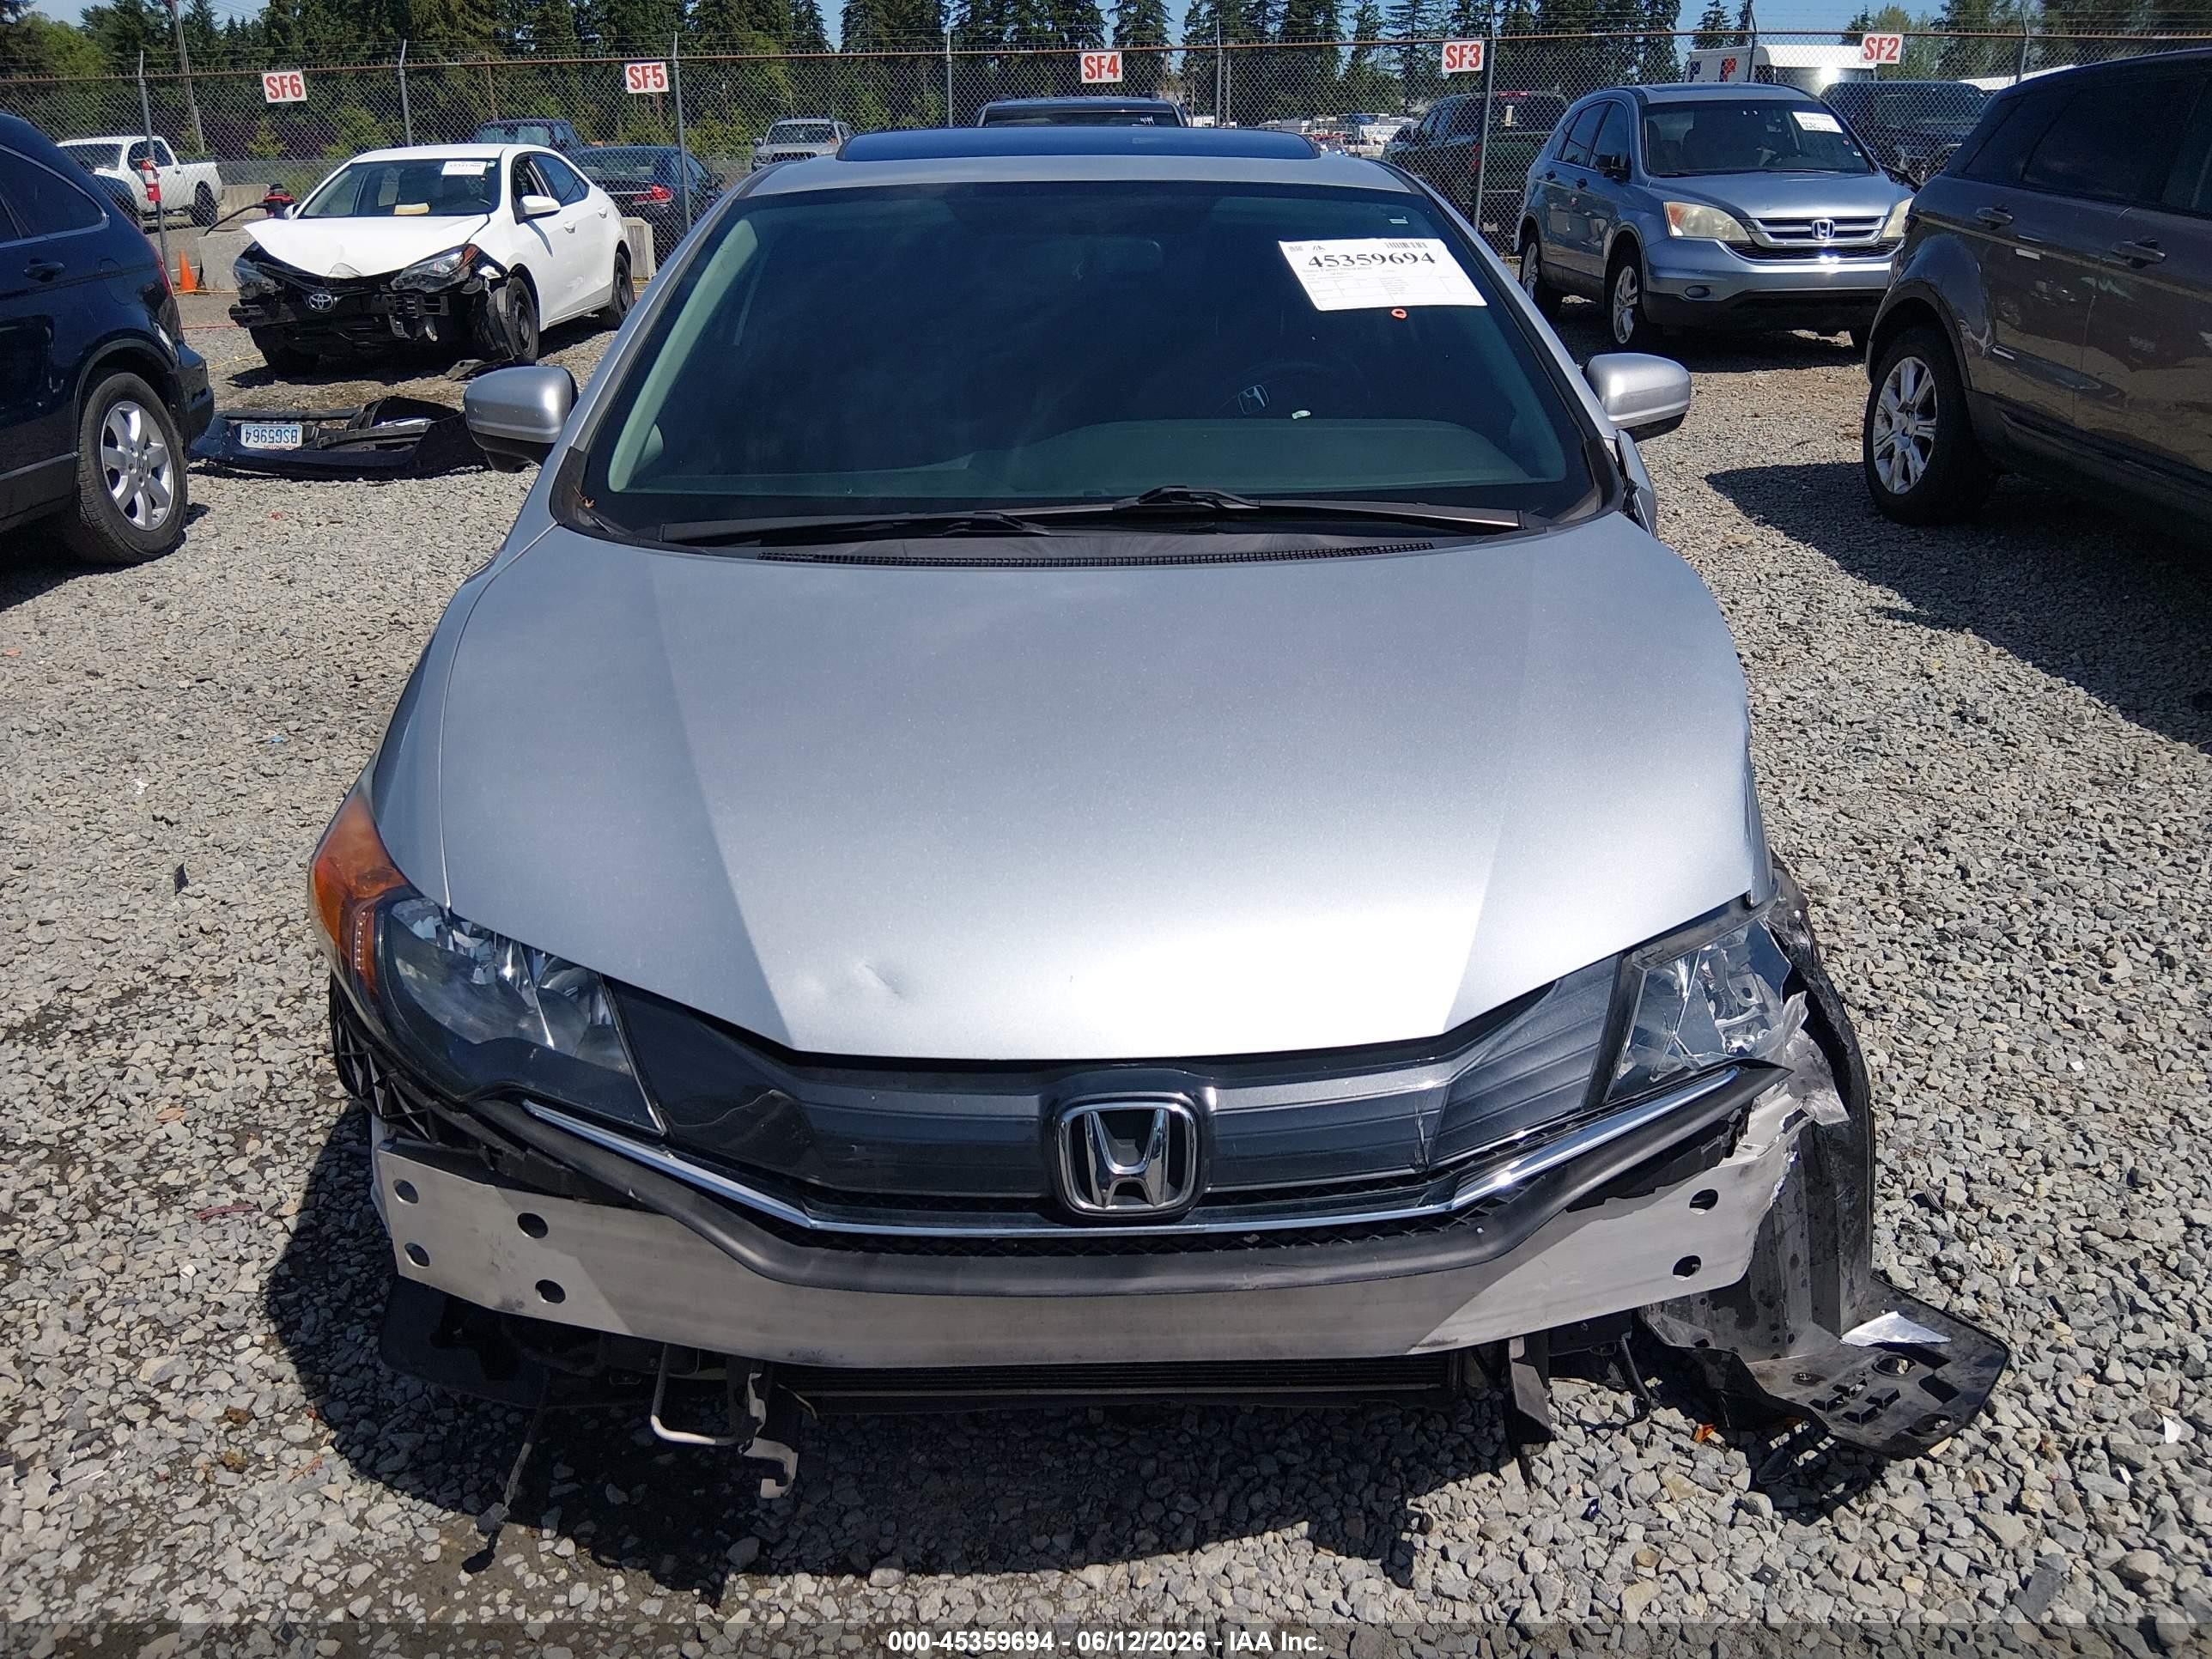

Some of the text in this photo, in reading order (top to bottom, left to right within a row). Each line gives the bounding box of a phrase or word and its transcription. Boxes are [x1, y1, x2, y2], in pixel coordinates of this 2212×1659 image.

[1445, 44, 1480, 69] SF3
[1863, 37, 1899, 60] SF2
[629, 65, 665, 90] SF5
[1084, 55, 1120, 80] SF4
[266, 74, 302, 100] SF6
[1308, 252, 1436, 268] 45359694
[246, 428, 298, 444] BSG5964
